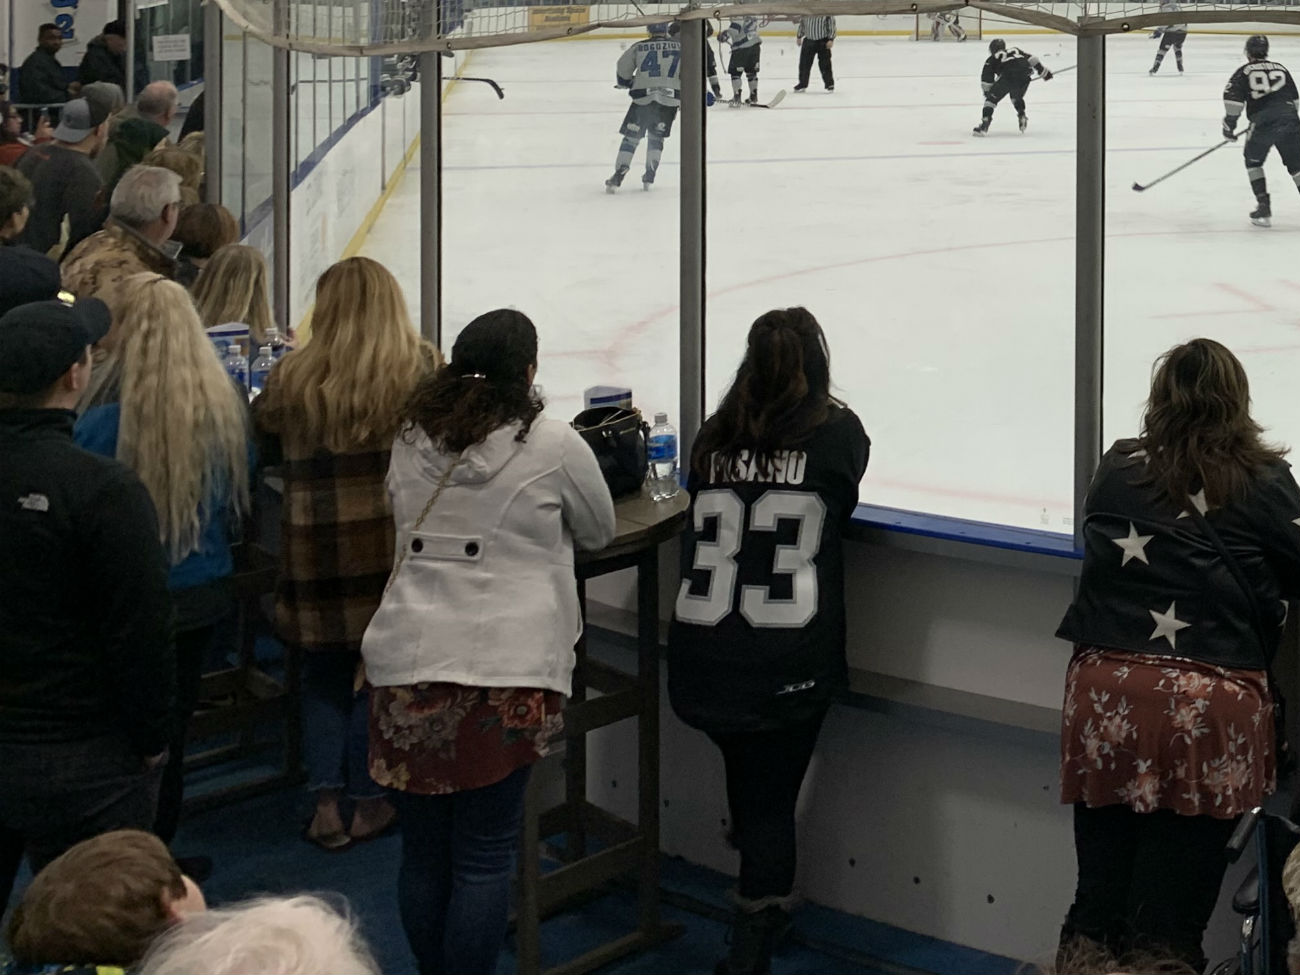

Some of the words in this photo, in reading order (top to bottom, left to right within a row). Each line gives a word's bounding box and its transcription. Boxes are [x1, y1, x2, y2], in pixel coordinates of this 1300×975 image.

[640, 50, 681, 78] 47
[1248, 70, 1286, 100] 92
[675, 488, 828, 628] 33
